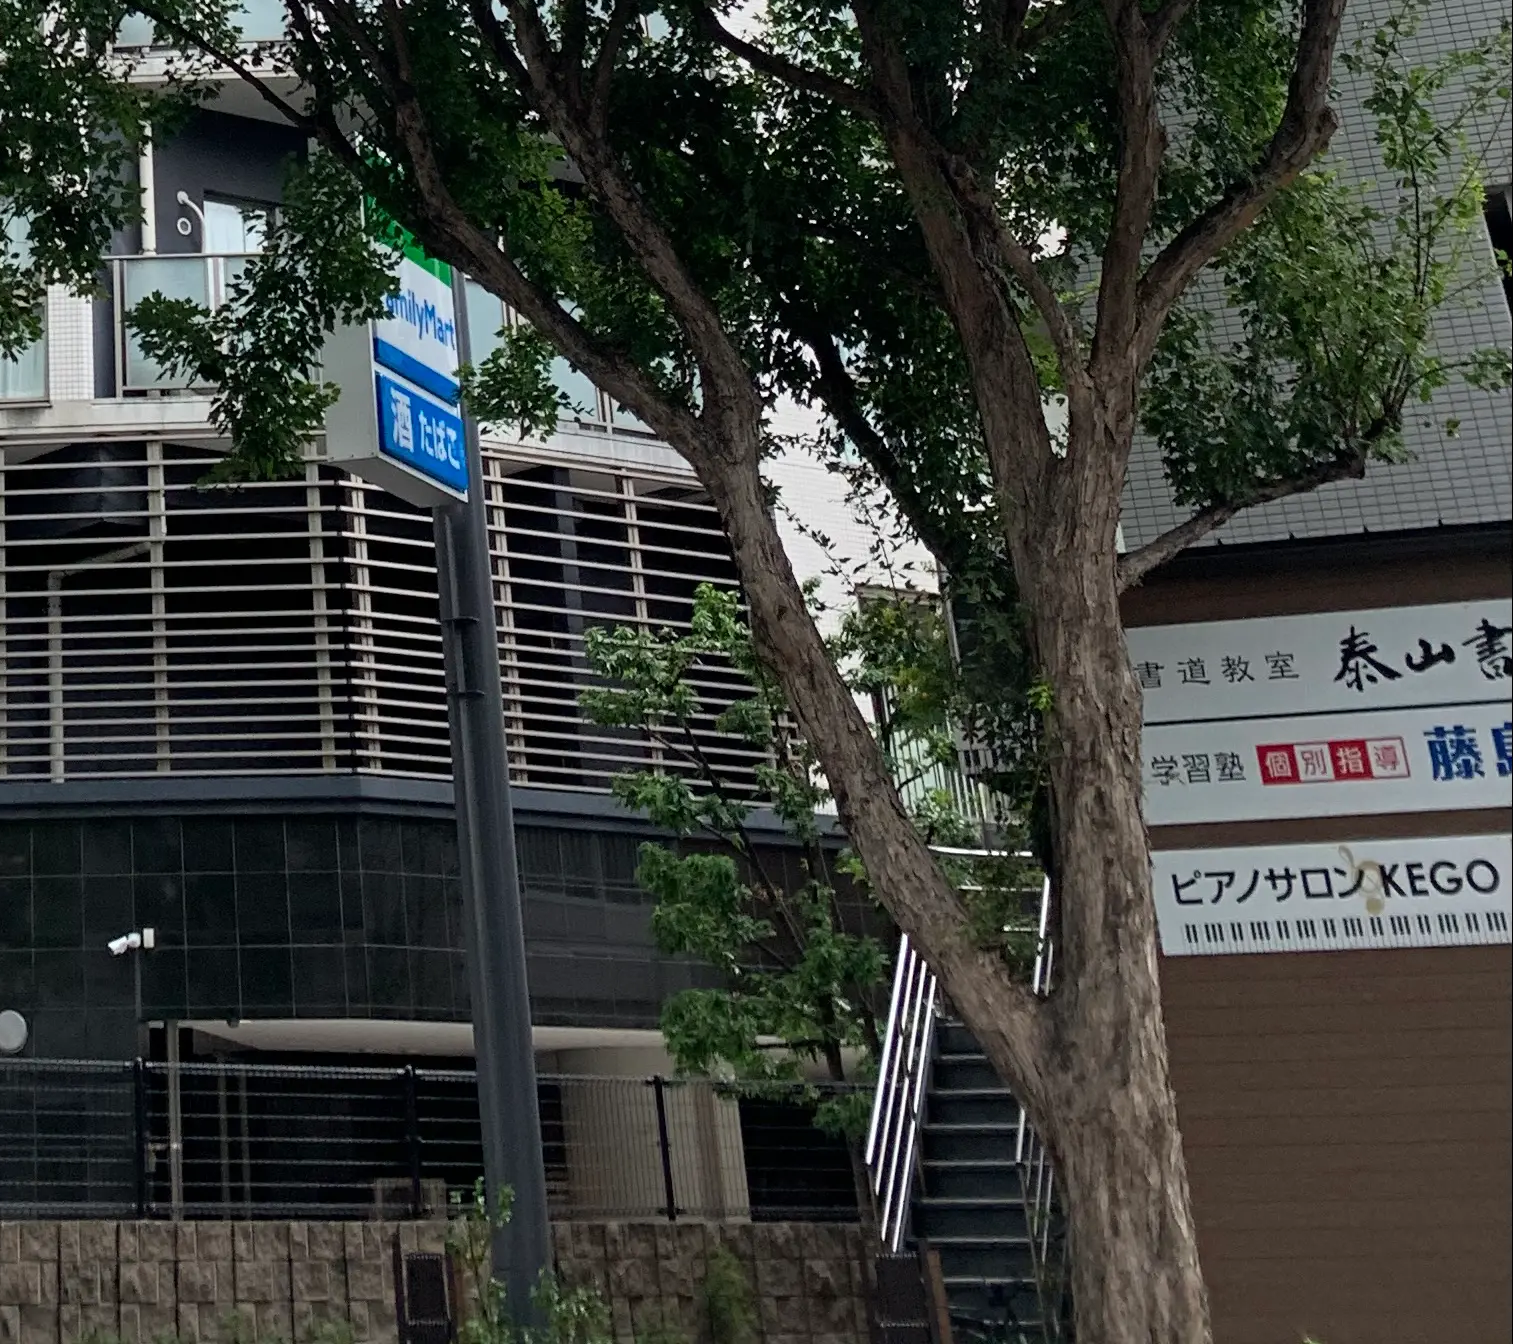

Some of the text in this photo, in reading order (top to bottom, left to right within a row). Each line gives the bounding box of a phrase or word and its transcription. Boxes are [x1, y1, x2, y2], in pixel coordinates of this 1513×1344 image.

[385, 288, 456, 351] amilyMart
[390, 386, 461, 470] 酒 たばこ
[1133, 650, 1300, 690] 書道教室
[1151, 751, 1247, 787] 学習塾
[1265, 743, 1400, 780] 個別指導
[1171, 859, 1501, 906] ピアノサロン KEGO
